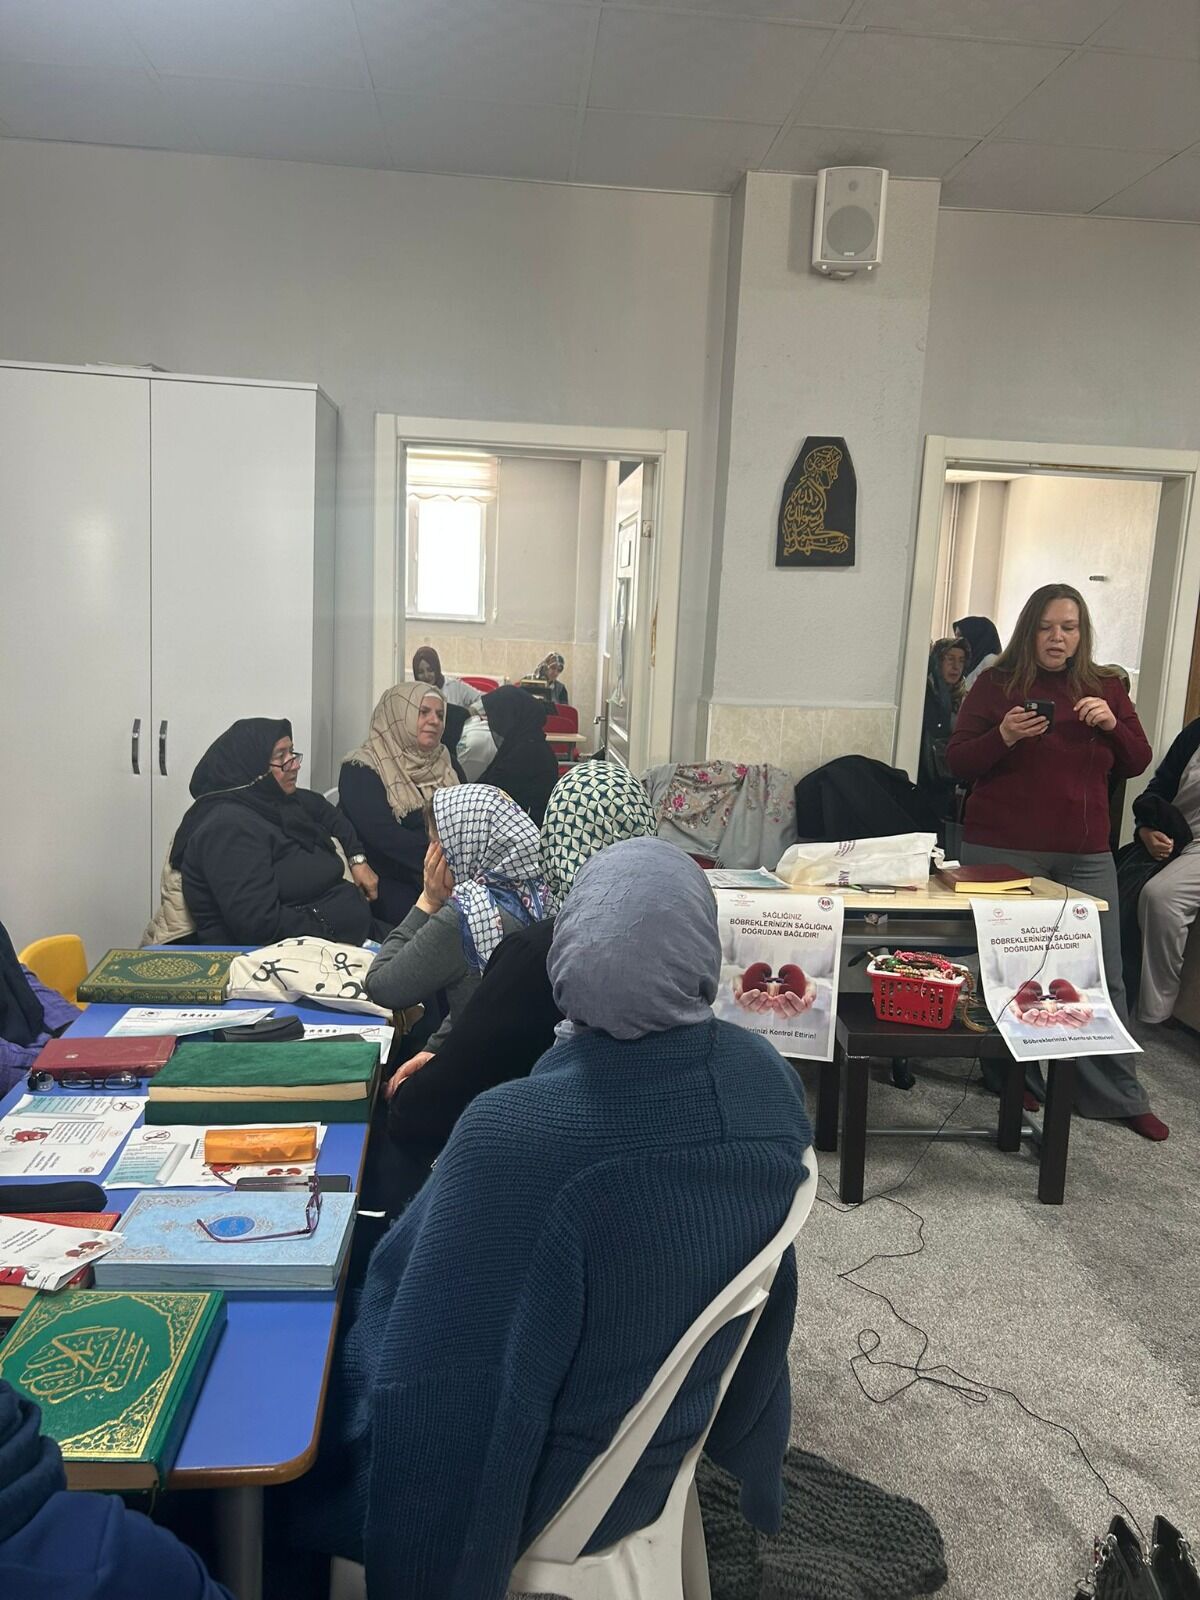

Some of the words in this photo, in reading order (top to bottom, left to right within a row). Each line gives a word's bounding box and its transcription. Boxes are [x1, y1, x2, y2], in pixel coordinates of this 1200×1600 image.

[762, 911, 802, 921] SAĞLIĞINIZ
[794, 922, 833, 931] SAĞLIĞINA
[741, 927, 782, 936] DOĞRUDAN
[783, 930, 819, 939] BAĞLIDIR!
[1003, 944, 1044, 953] DOĞRUDAN
[769, 1028, 793, 1037] Kontrol
